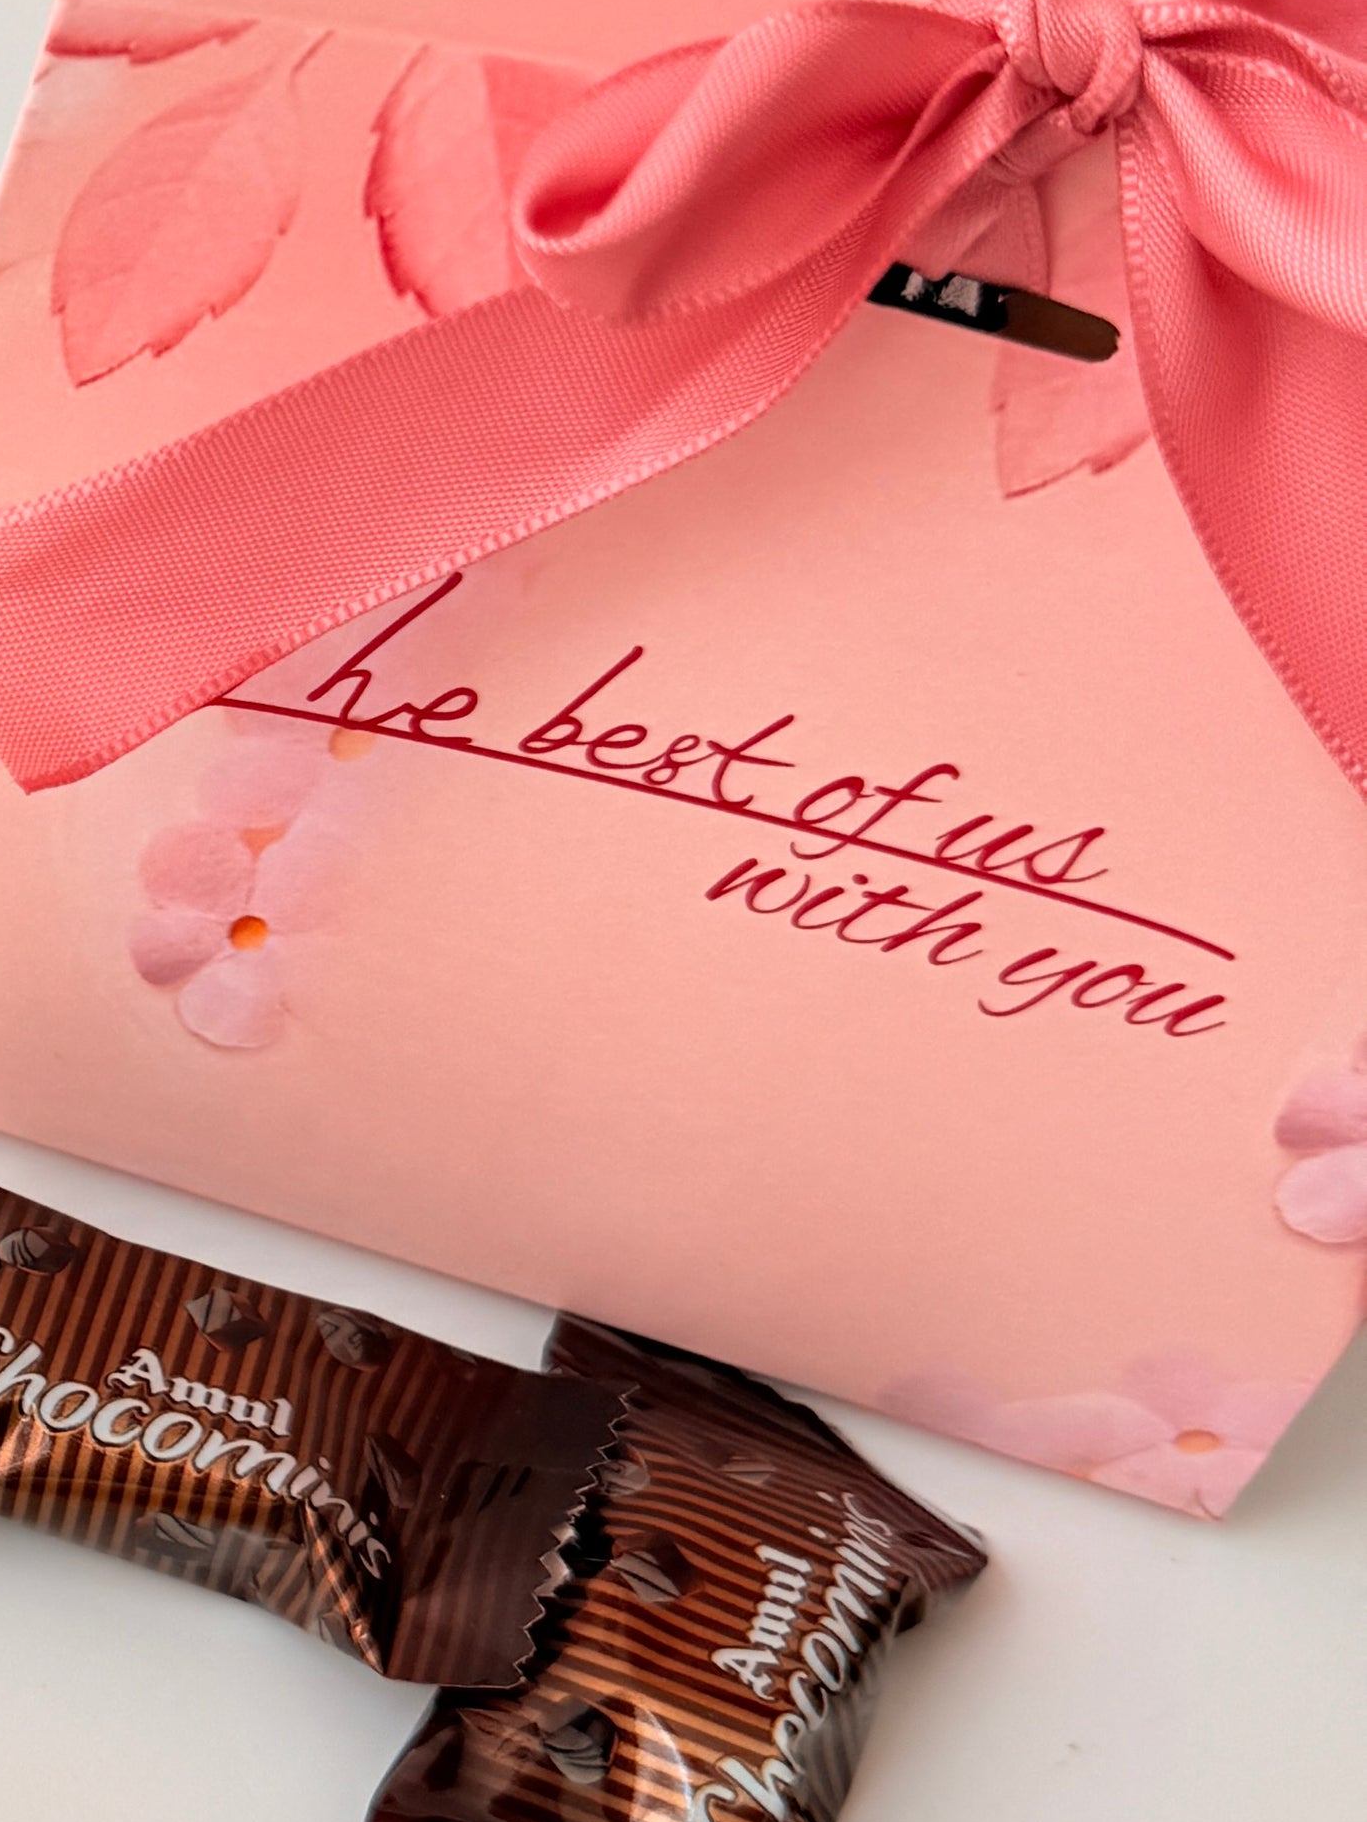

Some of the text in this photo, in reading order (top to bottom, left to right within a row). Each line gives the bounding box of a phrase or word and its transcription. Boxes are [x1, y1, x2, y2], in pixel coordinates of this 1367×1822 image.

[305, 570, 1110, 886] he best of us
[704, 855, 1227, 1039] with you
[105, 1346, 294, 1438] Amul
[710, 1542, 814, 1702] Amul
